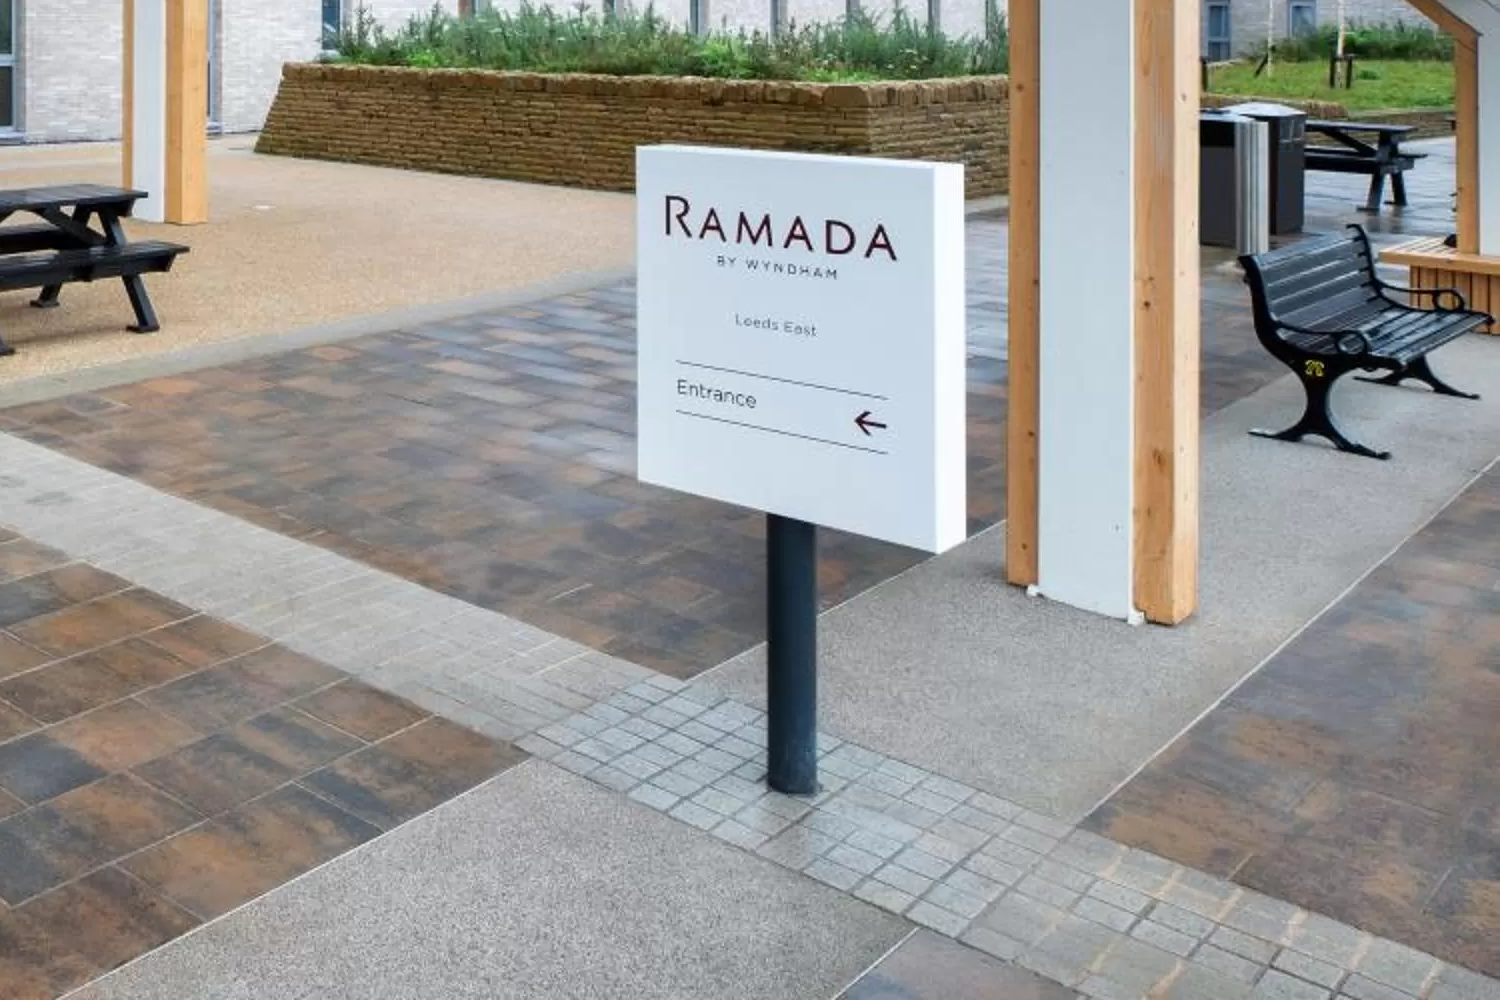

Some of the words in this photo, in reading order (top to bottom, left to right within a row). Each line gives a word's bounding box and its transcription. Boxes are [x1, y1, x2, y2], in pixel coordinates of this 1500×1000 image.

[665, 195, 898, 262] RAMADA
[716, 255, 737, 267] BY
[747, 259, 838, 279] WYNDHAM
[784, 321, 817, 337] East
[677, 379, 757, 409] Entrance
